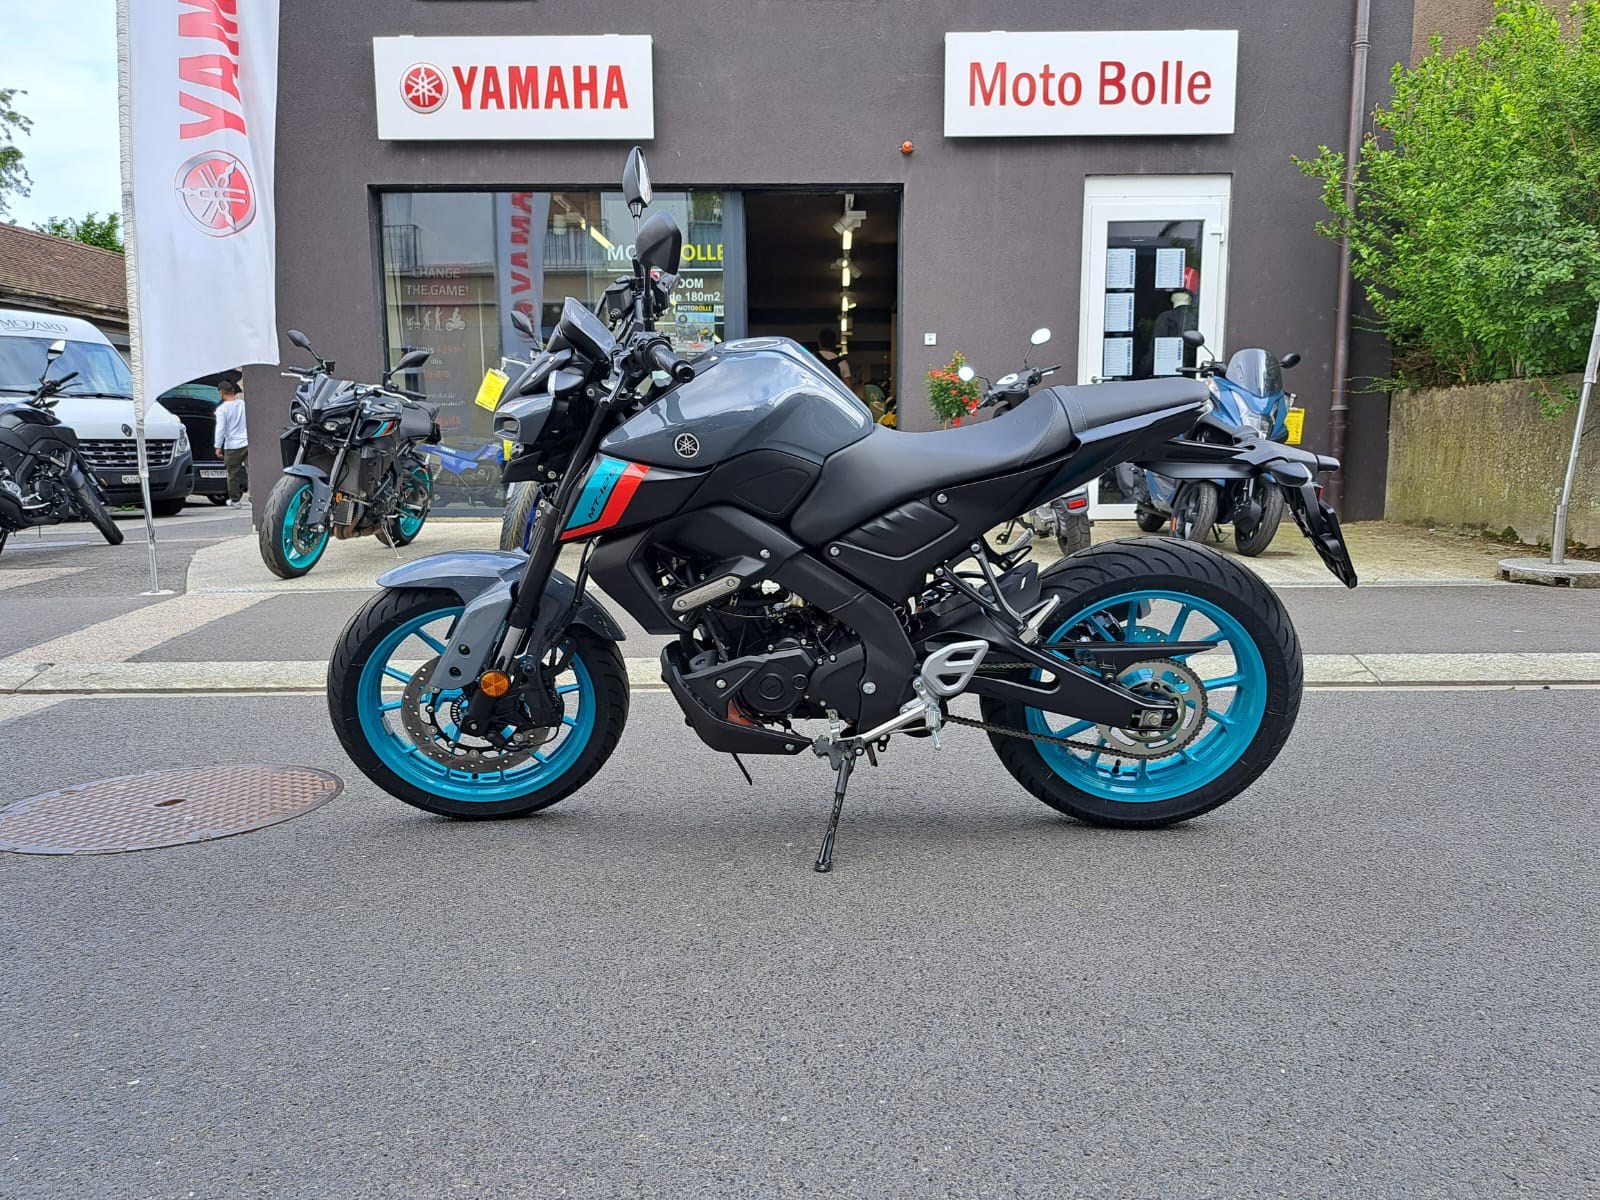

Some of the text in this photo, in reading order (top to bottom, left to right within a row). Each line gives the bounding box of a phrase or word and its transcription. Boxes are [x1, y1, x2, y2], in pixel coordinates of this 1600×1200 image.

[452, 65, 628, 110] YAMAHA
[969, 60, 1212, 107] Moto Bolle
[413, 268, 461, 278] CHANGE
[406, 284, 469, 297] THE GAME!
[685, 291, 720, 302] 180m2
